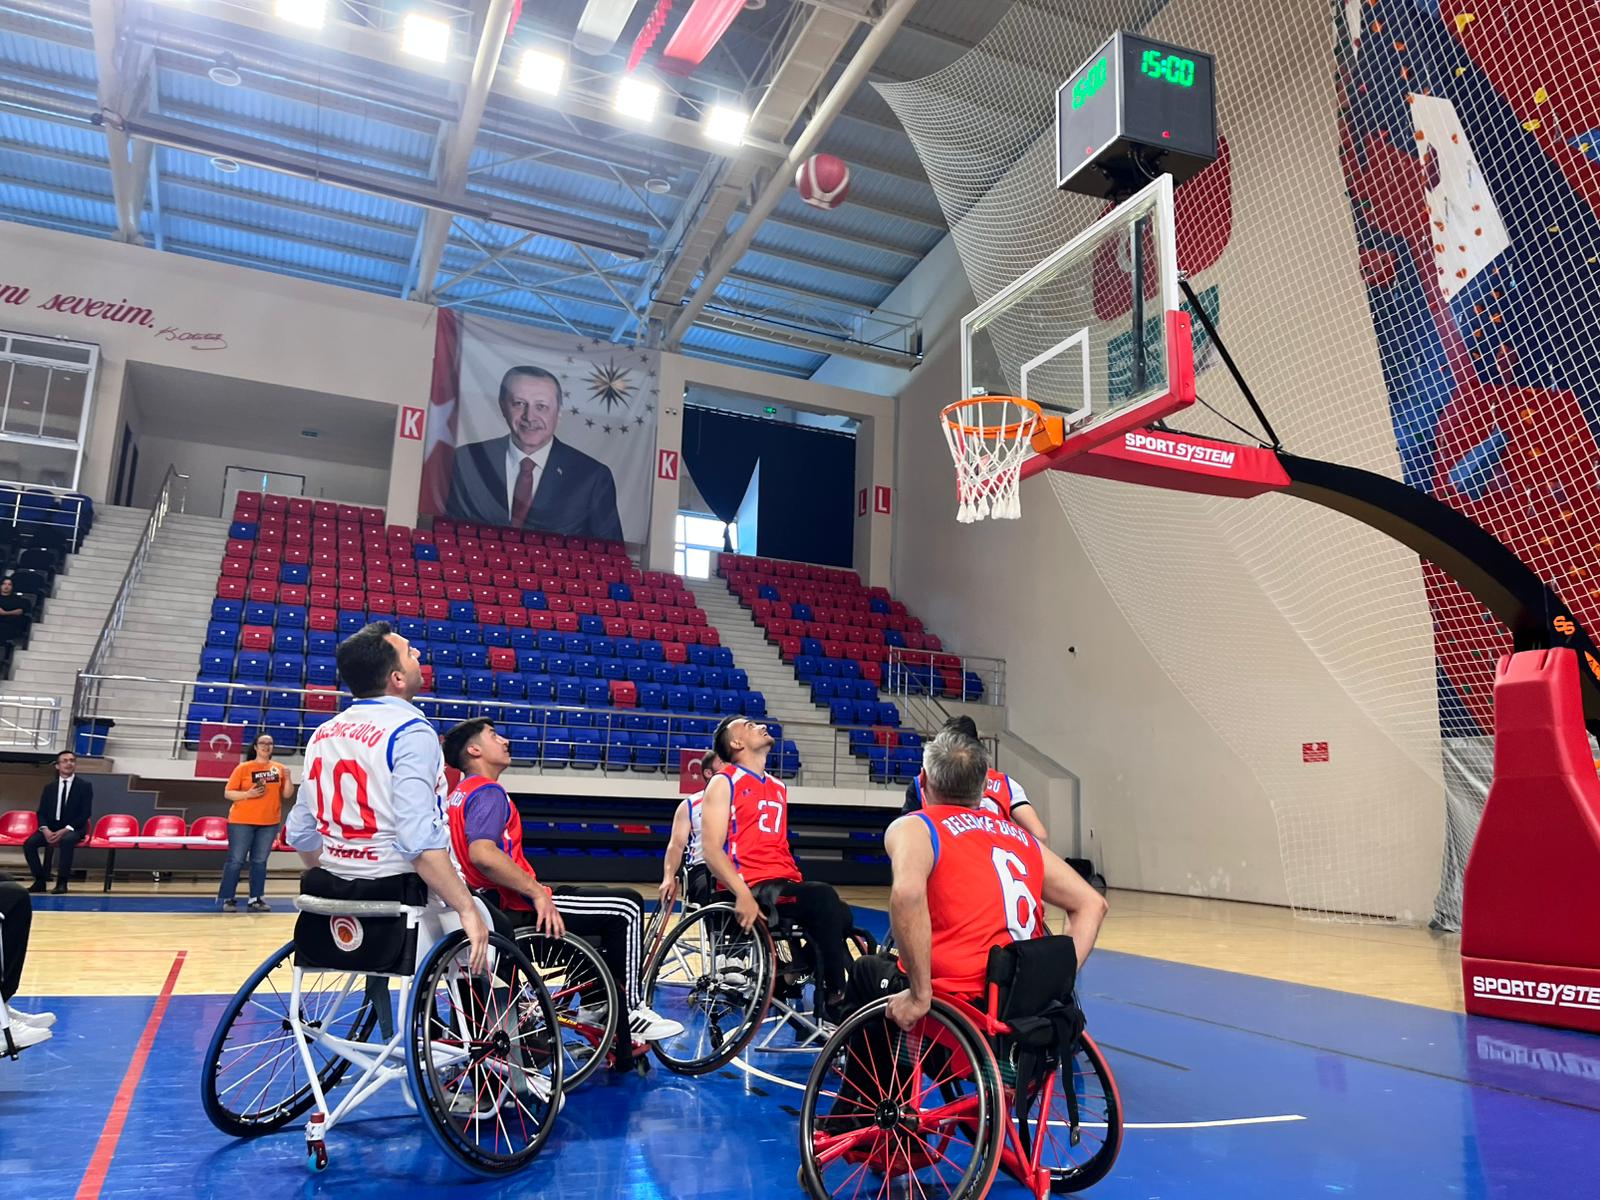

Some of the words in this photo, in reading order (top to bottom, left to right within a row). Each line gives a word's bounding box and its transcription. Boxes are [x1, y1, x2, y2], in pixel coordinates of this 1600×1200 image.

[1141, 49, 1195, 87] 15:00
[37, 293, 155, 328] severim.
[404, 409, 421, 438] K
[1125, 432, 1176, 453] SPORT
[1176, 443, 1235, 465] SYSTEM
[662, 453, 675, 478] K
[878, 488, 888, 512] L
[308, 757, 378, 840] 10
[758, 800, 783, 833] 27
[991, 845, 1037, 941] 6
[1473, 976, 1536, 997] SPORT
